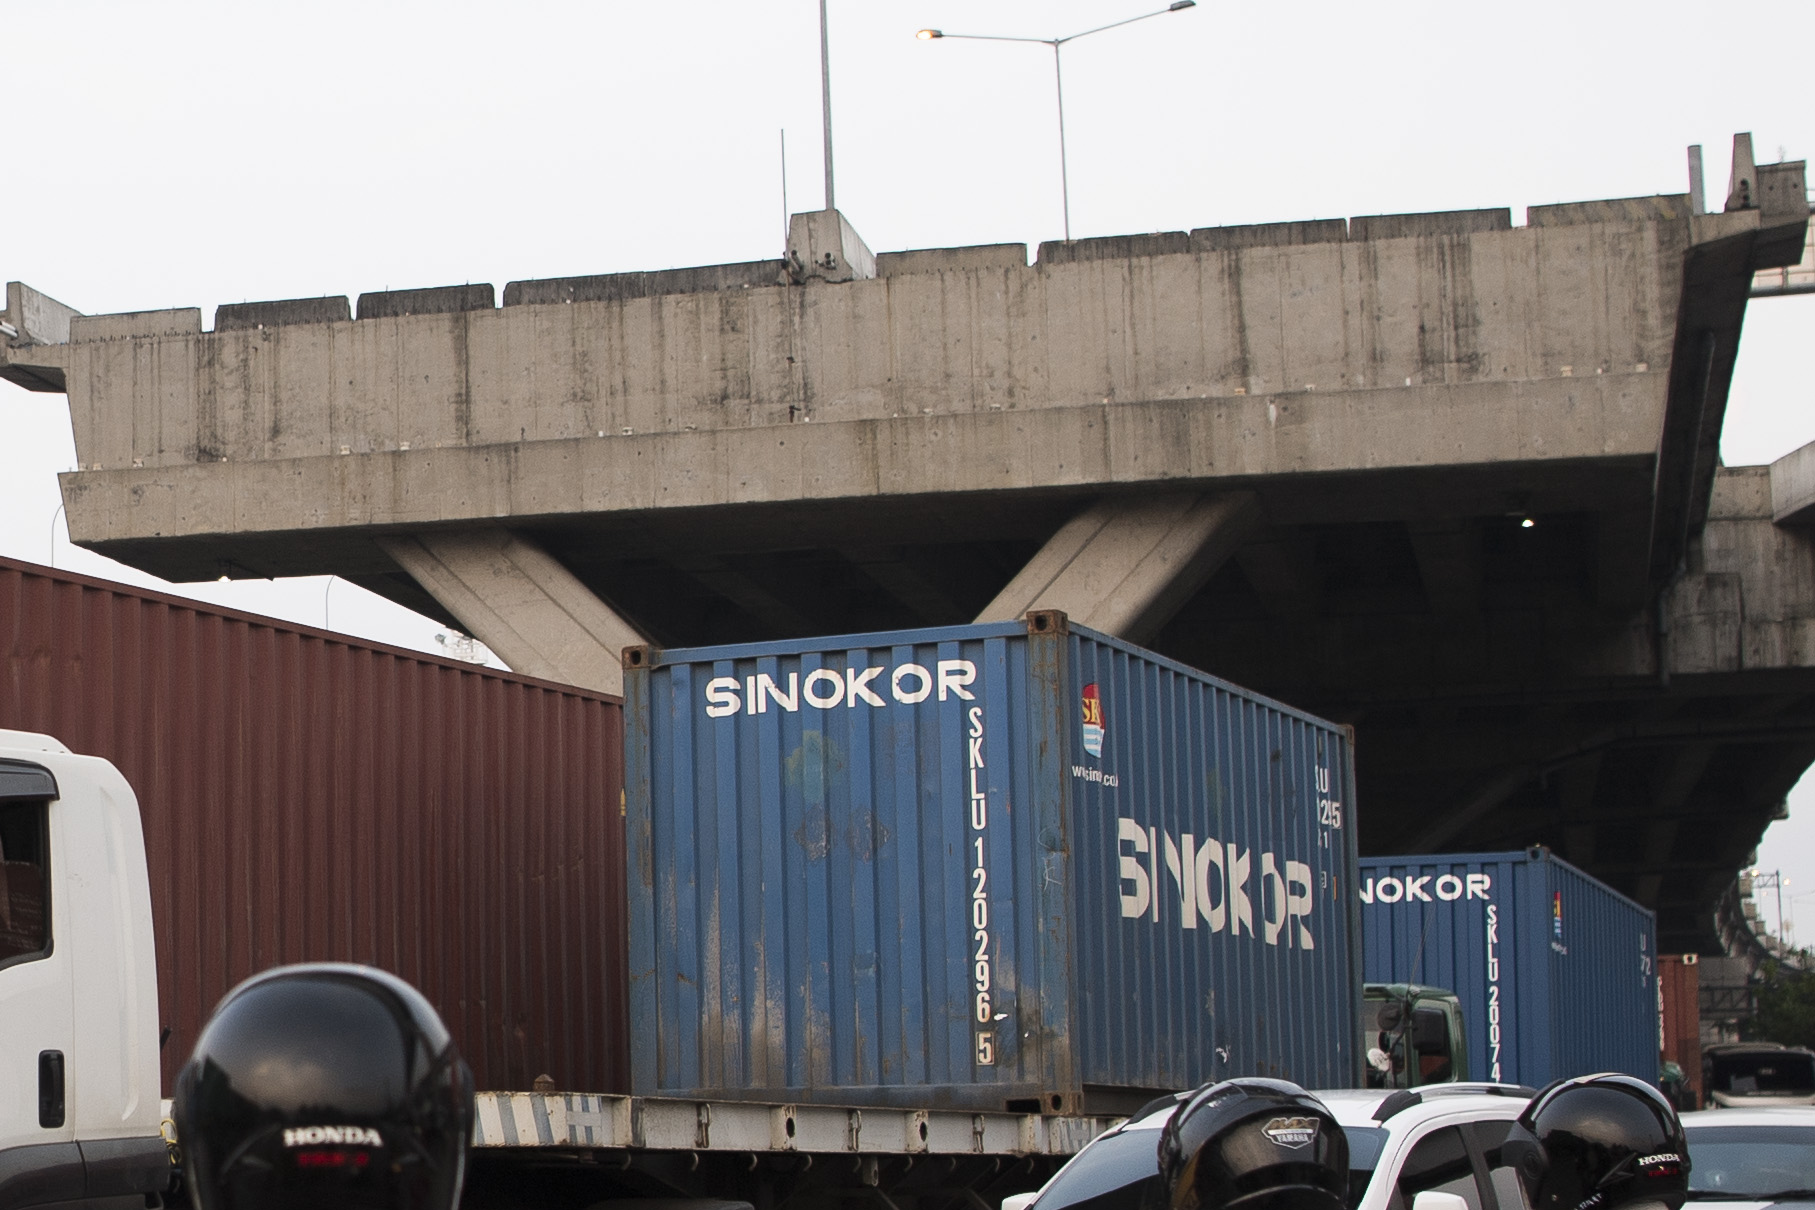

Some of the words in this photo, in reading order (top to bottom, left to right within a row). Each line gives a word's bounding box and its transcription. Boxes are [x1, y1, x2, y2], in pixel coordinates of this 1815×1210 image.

[705, 659, 977, 718] SINOKOR
[968, 706, 987, 831] SKLU
[972, 836, 991, 1023] 120296
[1487, 904, 1499, 982] SKLU
[283, 1126, 383, 1147] HONDA
[1638, 1153, 1681, 1166] HONDA
